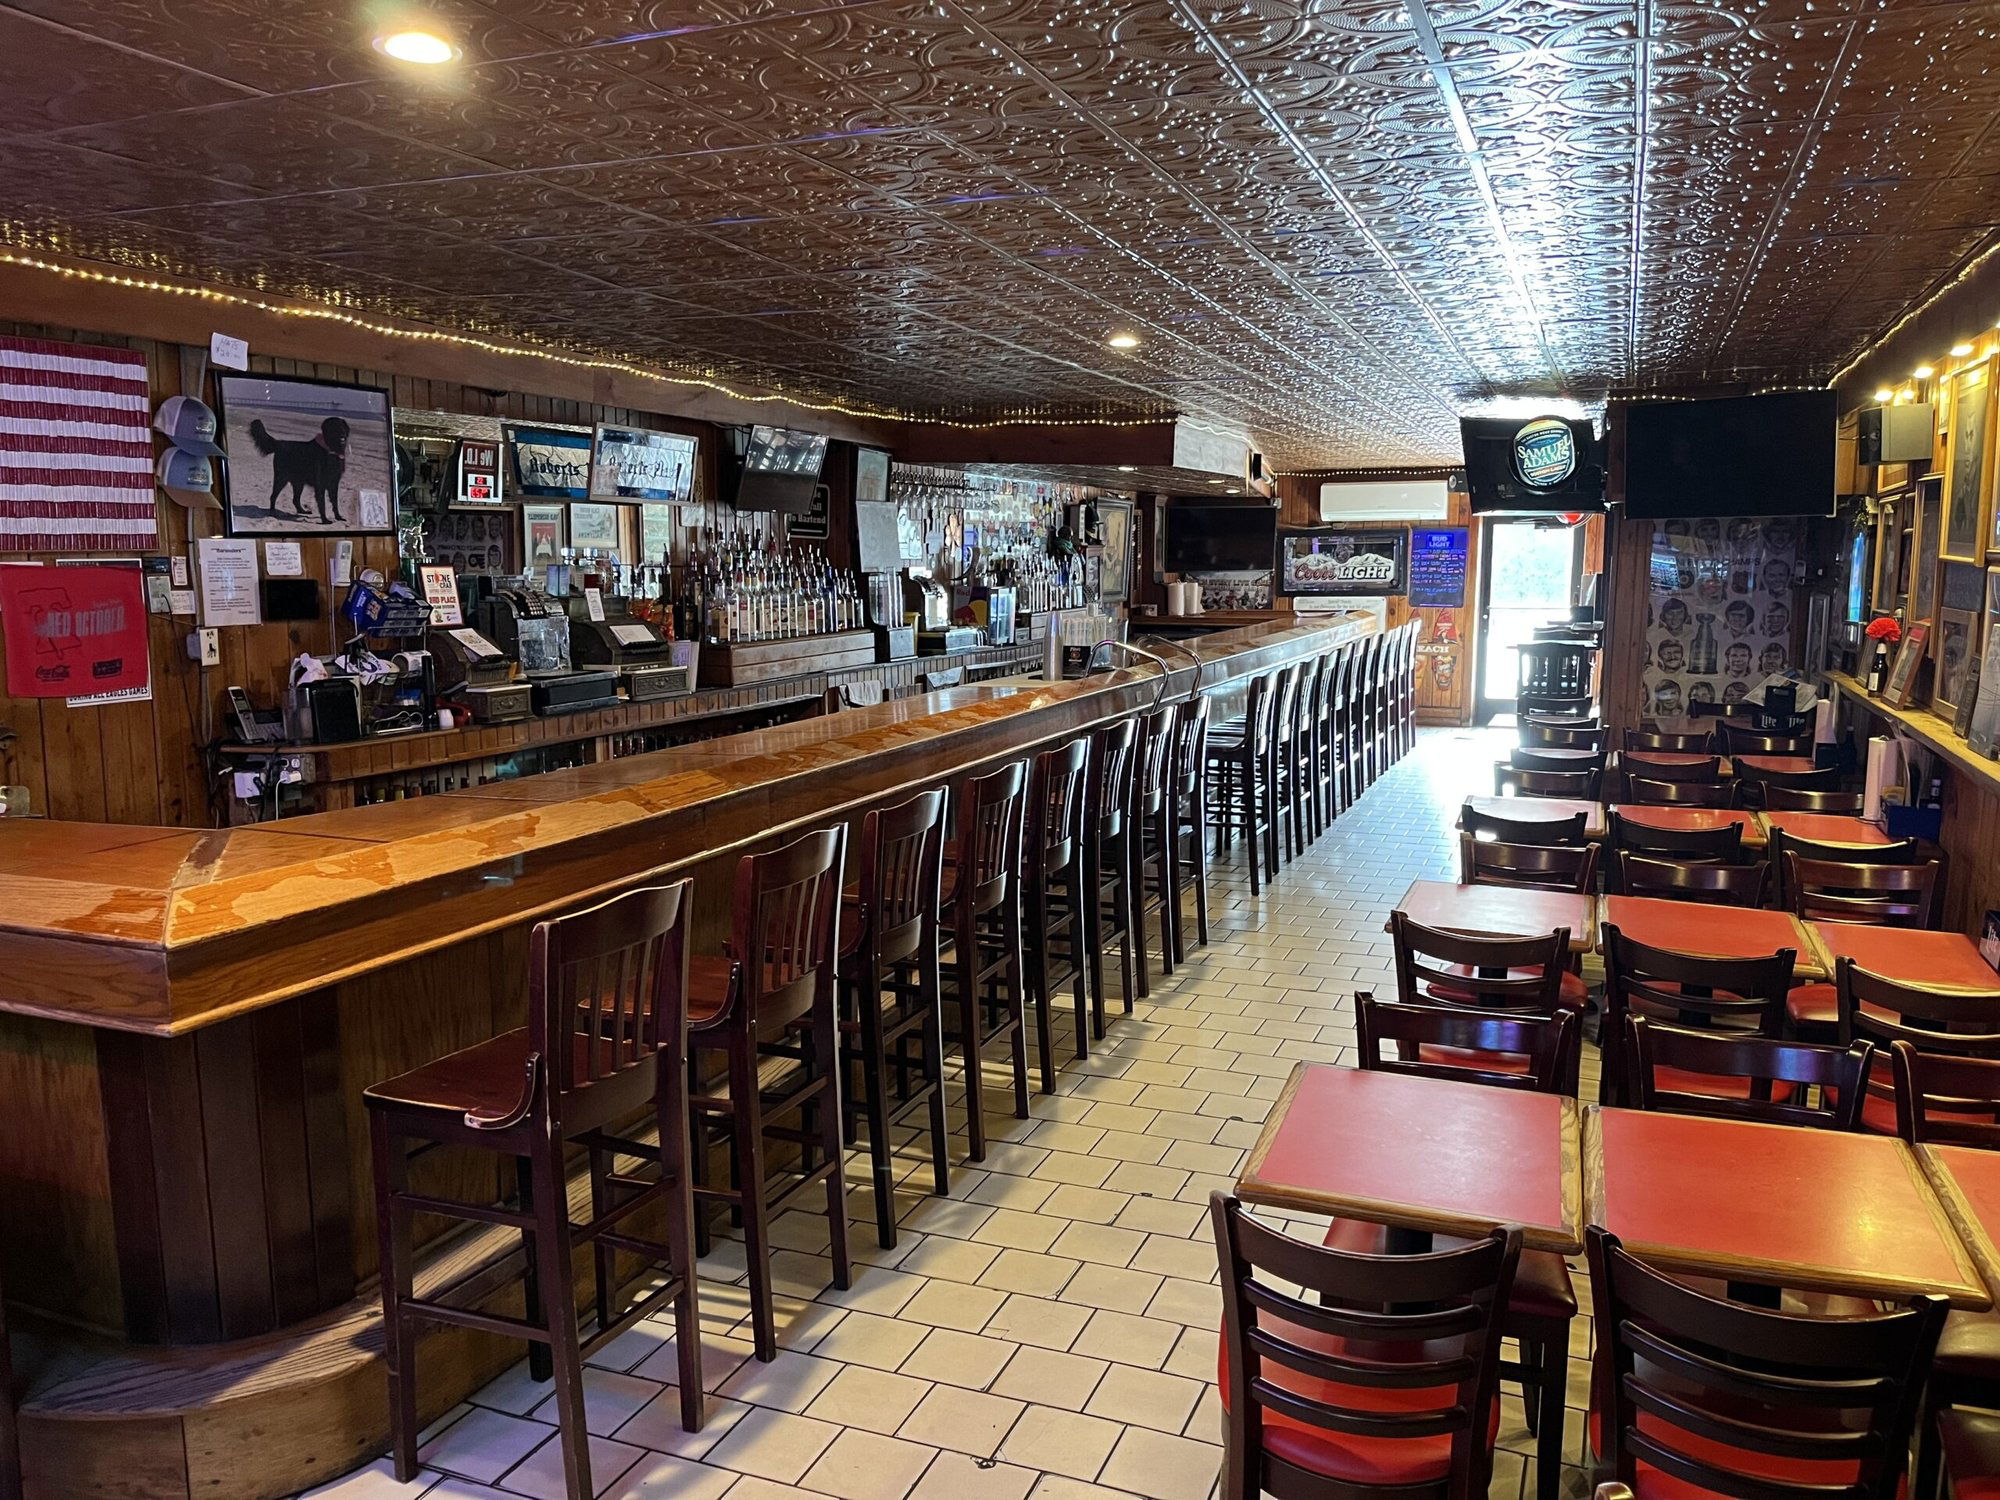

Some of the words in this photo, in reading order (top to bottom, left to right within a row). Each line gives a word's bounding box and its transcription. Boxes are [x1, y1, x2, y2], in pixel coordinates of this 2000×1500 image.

[1517, 434, 1571, 459] SAMUEL
[528, 456, 582, 476] Roberts
[1523, 446, 1570, 469] ADAMS
[788, 513, 797, 522] To
[798, 514, 826, 524] Bartend
[1294, 562, 1337, 581] Coors
[1337, 565, 1391, 580] LIGHT
[75, 605, 125, 637] OCTOBER
[1416, 645, 1450, 653] EACH
[1761, 715, 1777, 729] Lite
